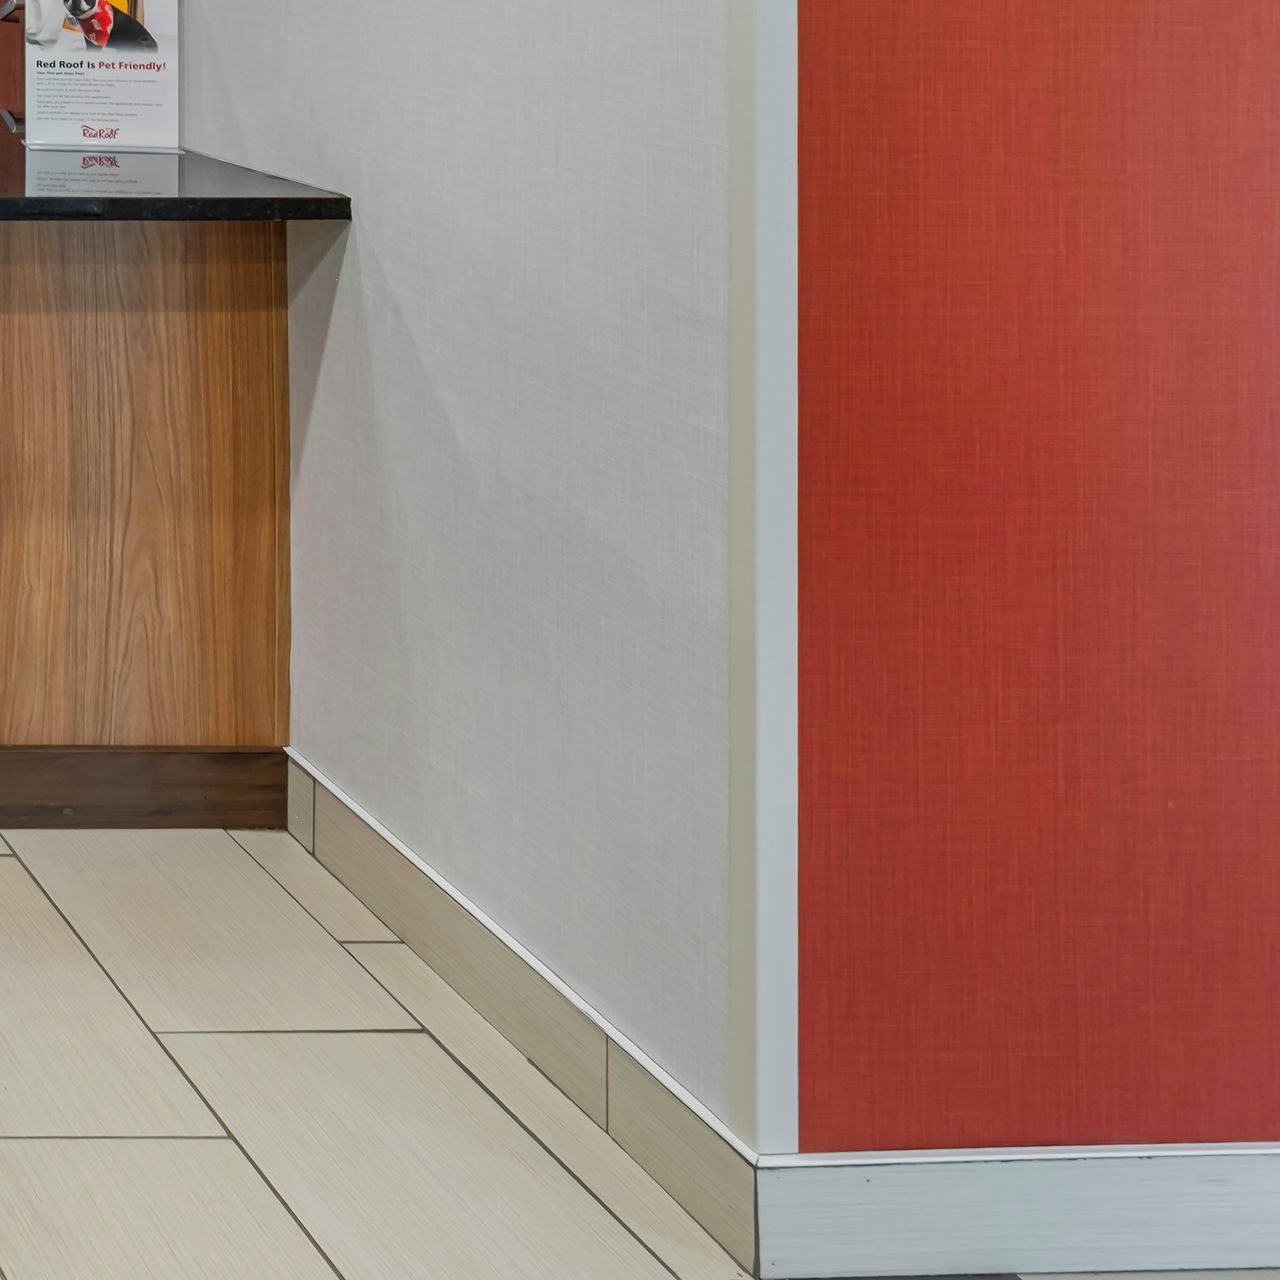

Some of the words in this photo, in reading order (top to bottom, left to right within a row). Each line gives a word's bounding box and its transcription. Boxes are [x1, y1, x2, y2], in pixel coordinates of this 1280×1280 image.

[36, 60, 56, 69] Red
[59, 60, 84, 69] Roof
[87, 61, 96, 69] Is
[98, 61, 116, 70] Pet
[118, 62, 167, 73] Friendly!
[82, 128, 99, 138] Red
